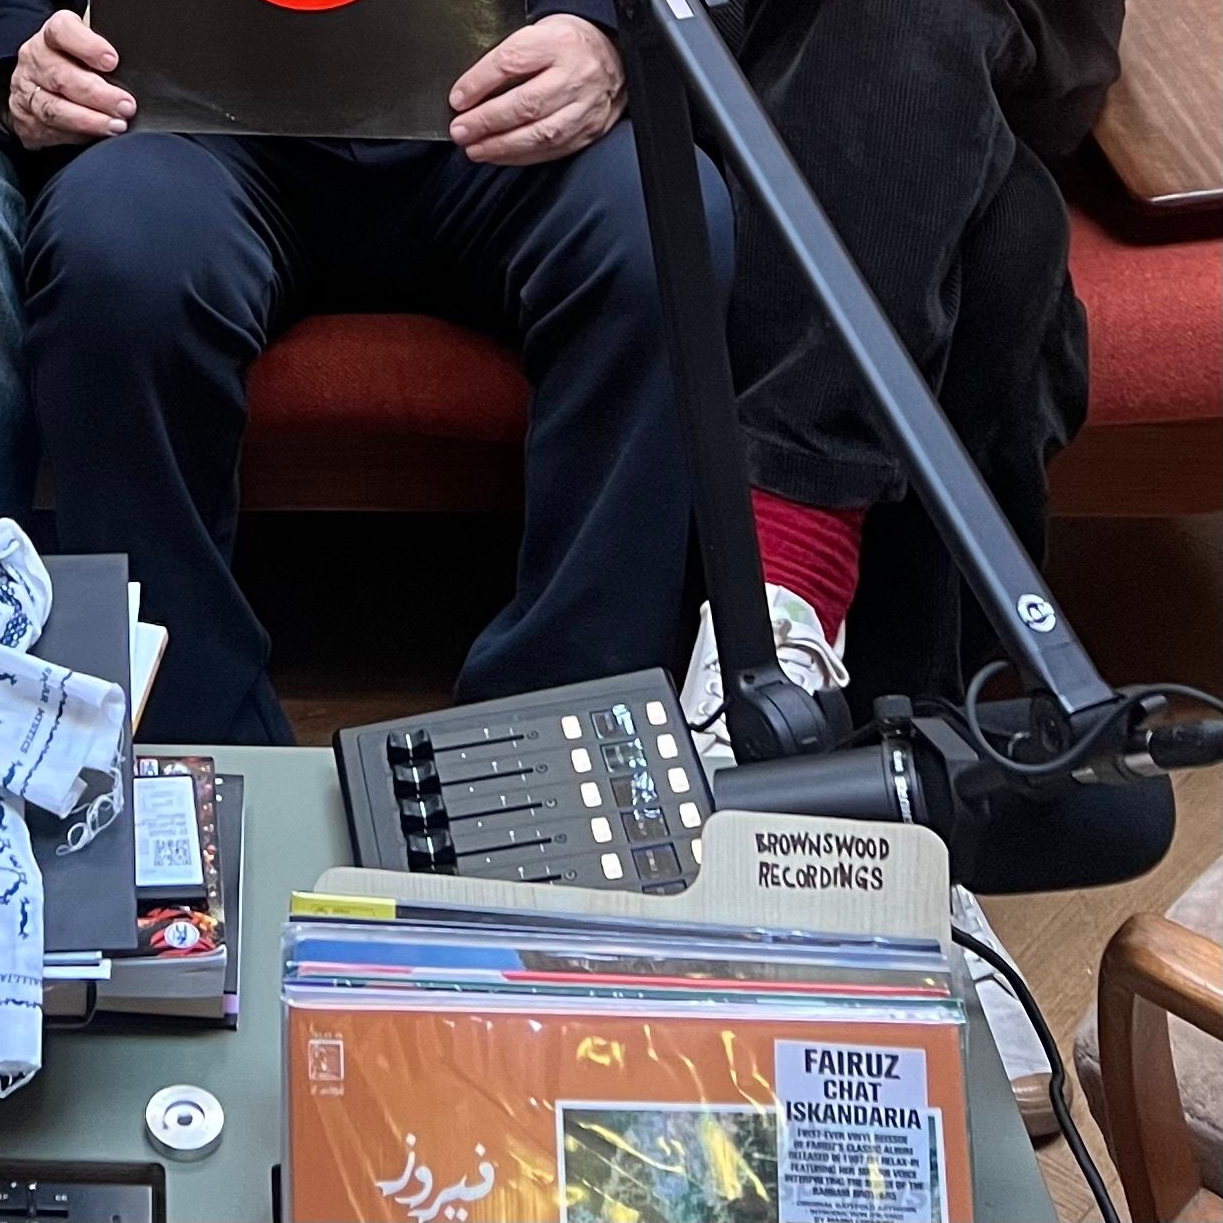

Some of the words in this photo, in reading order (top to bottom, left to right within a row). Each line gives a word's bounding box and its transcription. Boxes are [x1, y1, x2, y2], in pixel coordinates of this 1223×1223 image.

[755, 831, 890, 862] BROWNSWOOD
[758, 860, 884, 892] RECORDINGS
[804, 1048, 901, 1080] FAIRUZ
[823, 1079, 882, 1103] CHAT
[786, 1100, 922, 1130] ISKANDARIA
[375, 1132, 496, 1223] فيروز
